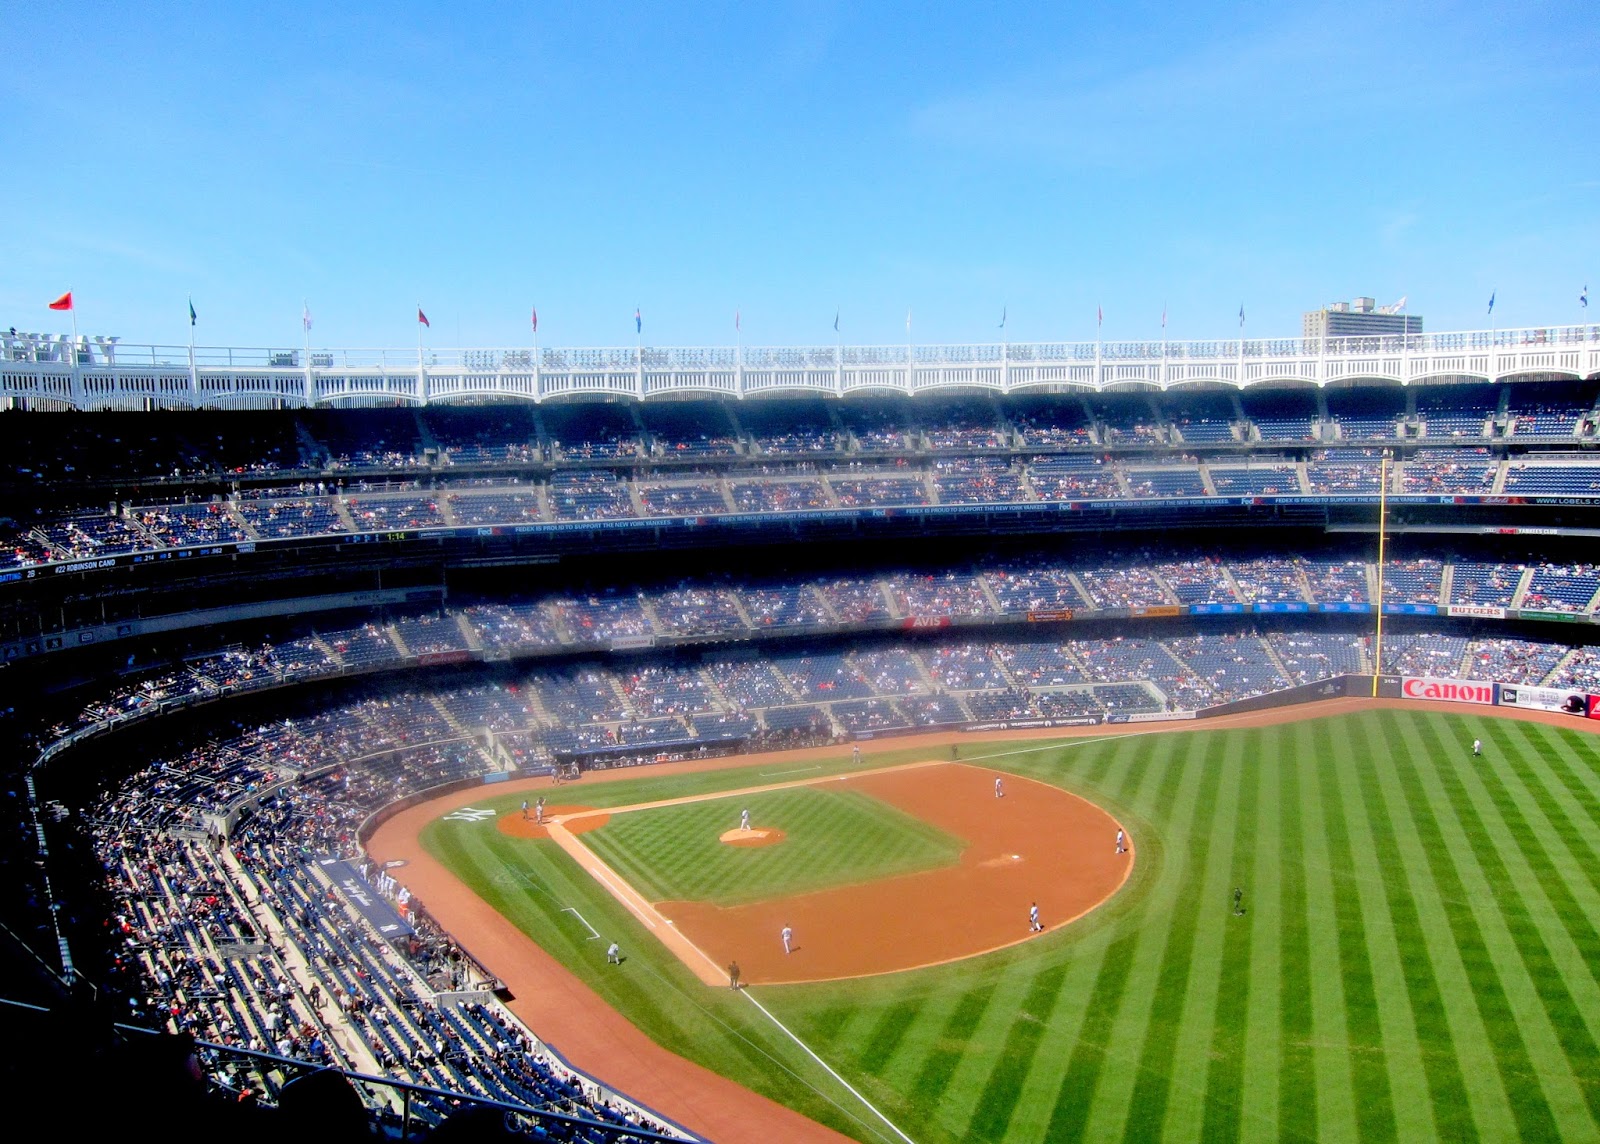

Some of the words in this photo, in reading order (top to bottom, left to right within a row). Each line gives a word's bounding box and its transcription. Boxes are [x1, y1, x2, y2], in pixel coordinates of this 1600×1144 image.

[66, 561, 97, 572] ROBINSON
[99, 559, 116, 567] CANO
[1451, 606, 1501, 616] RUTGERS
[913, 617, 940, 627] AVIS
[1404, 679, 1491, 702] Canon
